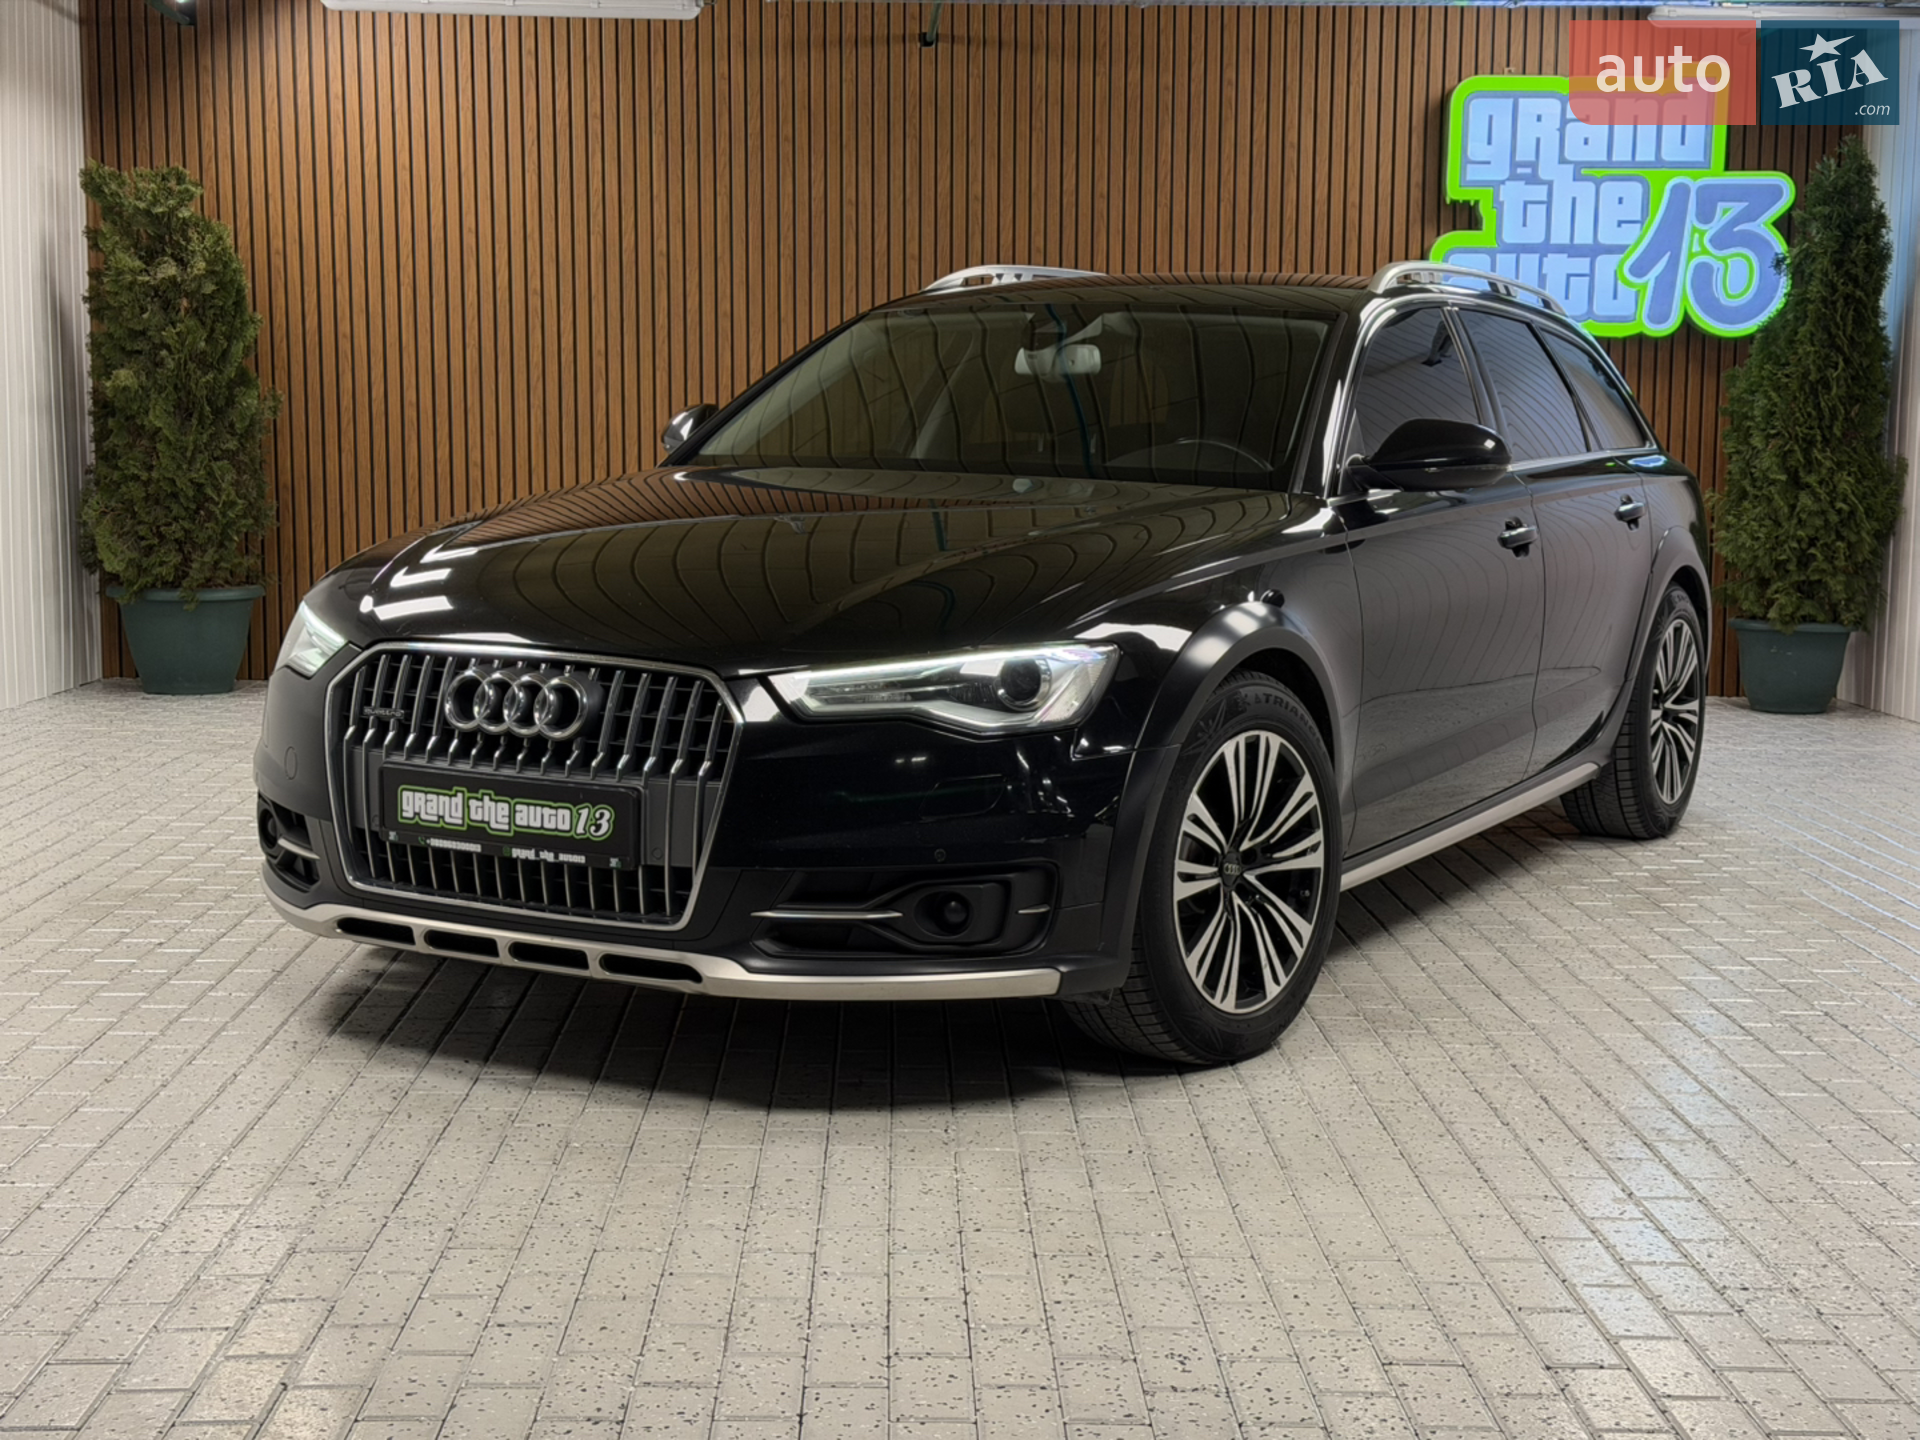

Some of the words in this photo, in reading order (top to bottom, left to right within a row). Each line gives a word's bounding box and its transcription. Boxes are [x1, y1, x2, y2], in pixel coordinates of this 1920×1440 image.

[1499, 163, 1644, 244] the
[1625, 177, 1791, 329] 13
[468, 795, 510, 831] the
[515, 804, 571, 832] auto
[575, 808, 612, 836] 13
